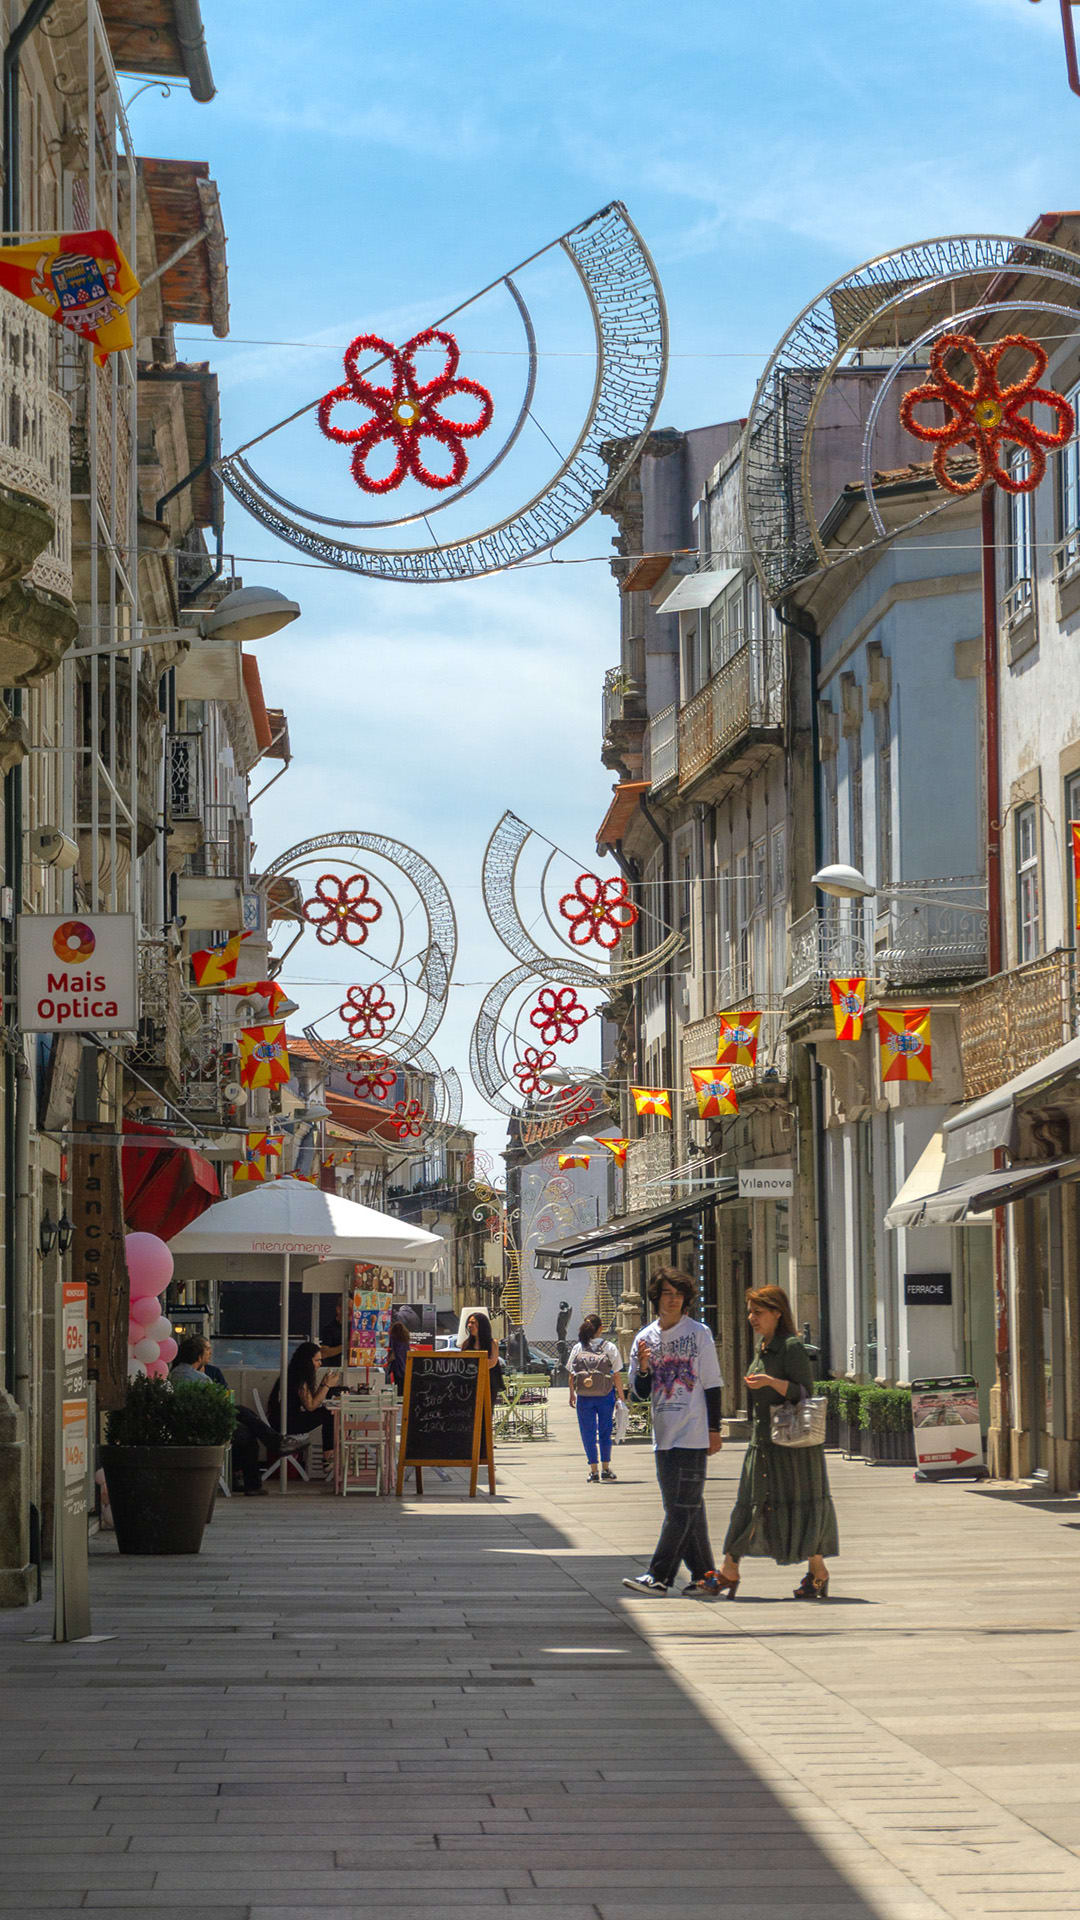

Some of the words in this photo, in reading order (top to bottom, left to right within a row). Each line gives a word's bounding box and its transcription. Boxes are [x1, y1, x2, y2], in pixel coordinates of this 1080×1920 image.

[47, 971, 106, 993] Mais
[37, 997, 118, 1024] Optica
[741, 1178, 792, 1188] Vilanova
[252, 1240, 332, 1253] intensamente
[907, 1285, 944, 1294] FERRACHE
